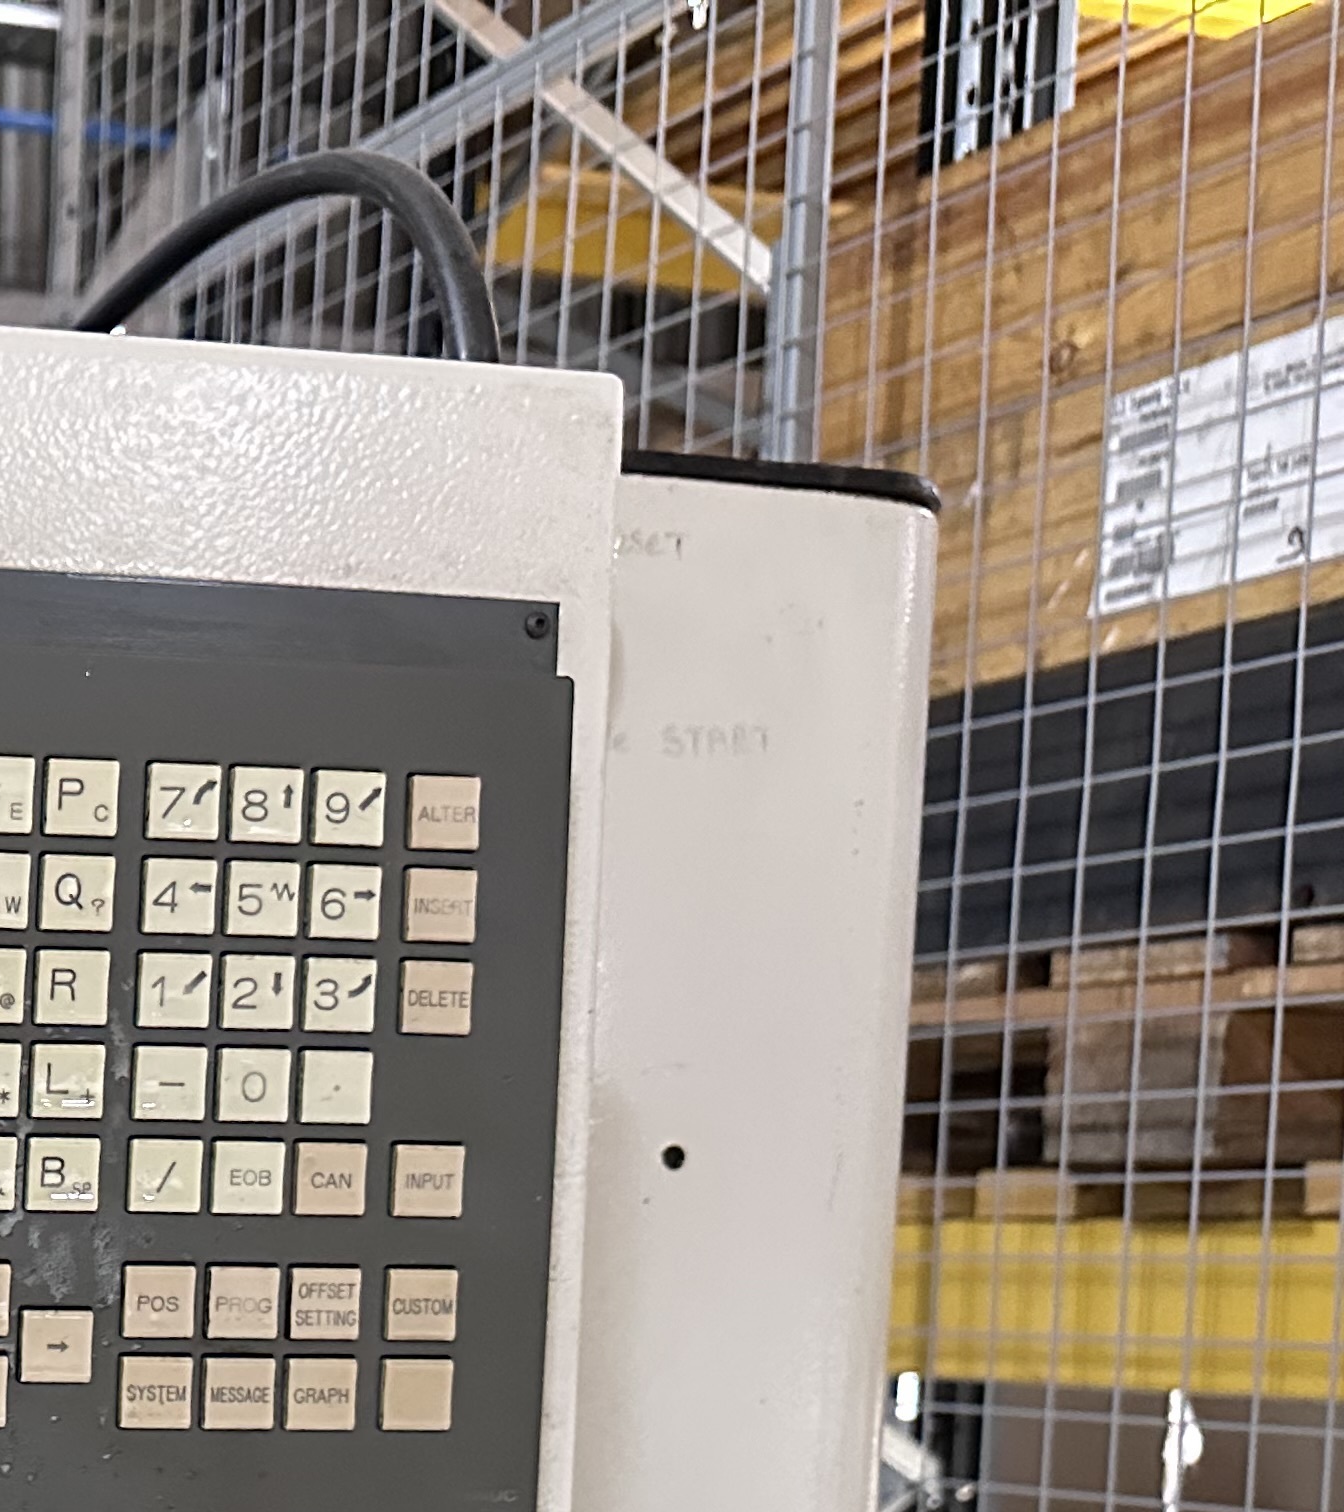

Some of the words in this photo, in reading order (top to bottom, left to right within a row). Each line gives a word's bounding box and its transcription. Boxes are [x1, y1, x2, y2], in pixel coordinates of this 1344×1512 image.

[58, 778, 84, 811] P
[159, 786, 185, 819] 7
[93, 804, 109, 823] C
[241, 789, 268, 822] 8
[324, 792, 350, 824] 9
[418, 805, 476, 824] ALTER
[54, 873, 83, 910] Q
[152, 881, 178, 913] 4
[238, 883, 263, 916] 5
[5, 897, 21, 913] W
[320, 888, 346, 920] 6
[413, 897, 473, 916] INSERT
[50, 968, 77, 1001] R
[152, 976, 165, 1007] 1
[232, 977, 258, 1009] 2
[313, 979, 339, 1011] 3
[408, 990, 469, 1009] DELETE
[45, 1062, 69, 1095] L
[40, 1156, 66, 1188] B
[229, 1168, 272, 1188] EOB
[311, 1172, 352, 1190] CAN
[405, 1173, 454, 1189] INPUT
[298, 1282, 356, 1300] OFFSET
[137, 1295, 179, 1313] POS
[216, 1295, 272, 1315] PROG
[393, 1297, 453, 1315] CUSTOM
[295, 1310, 357, 1328] SETTING
[127, 1385, 186, 1402] SYSTEM
[211, 1386, 270, 1404] MESSAGE
[293, 1387, 349, 1405] GRAPH
